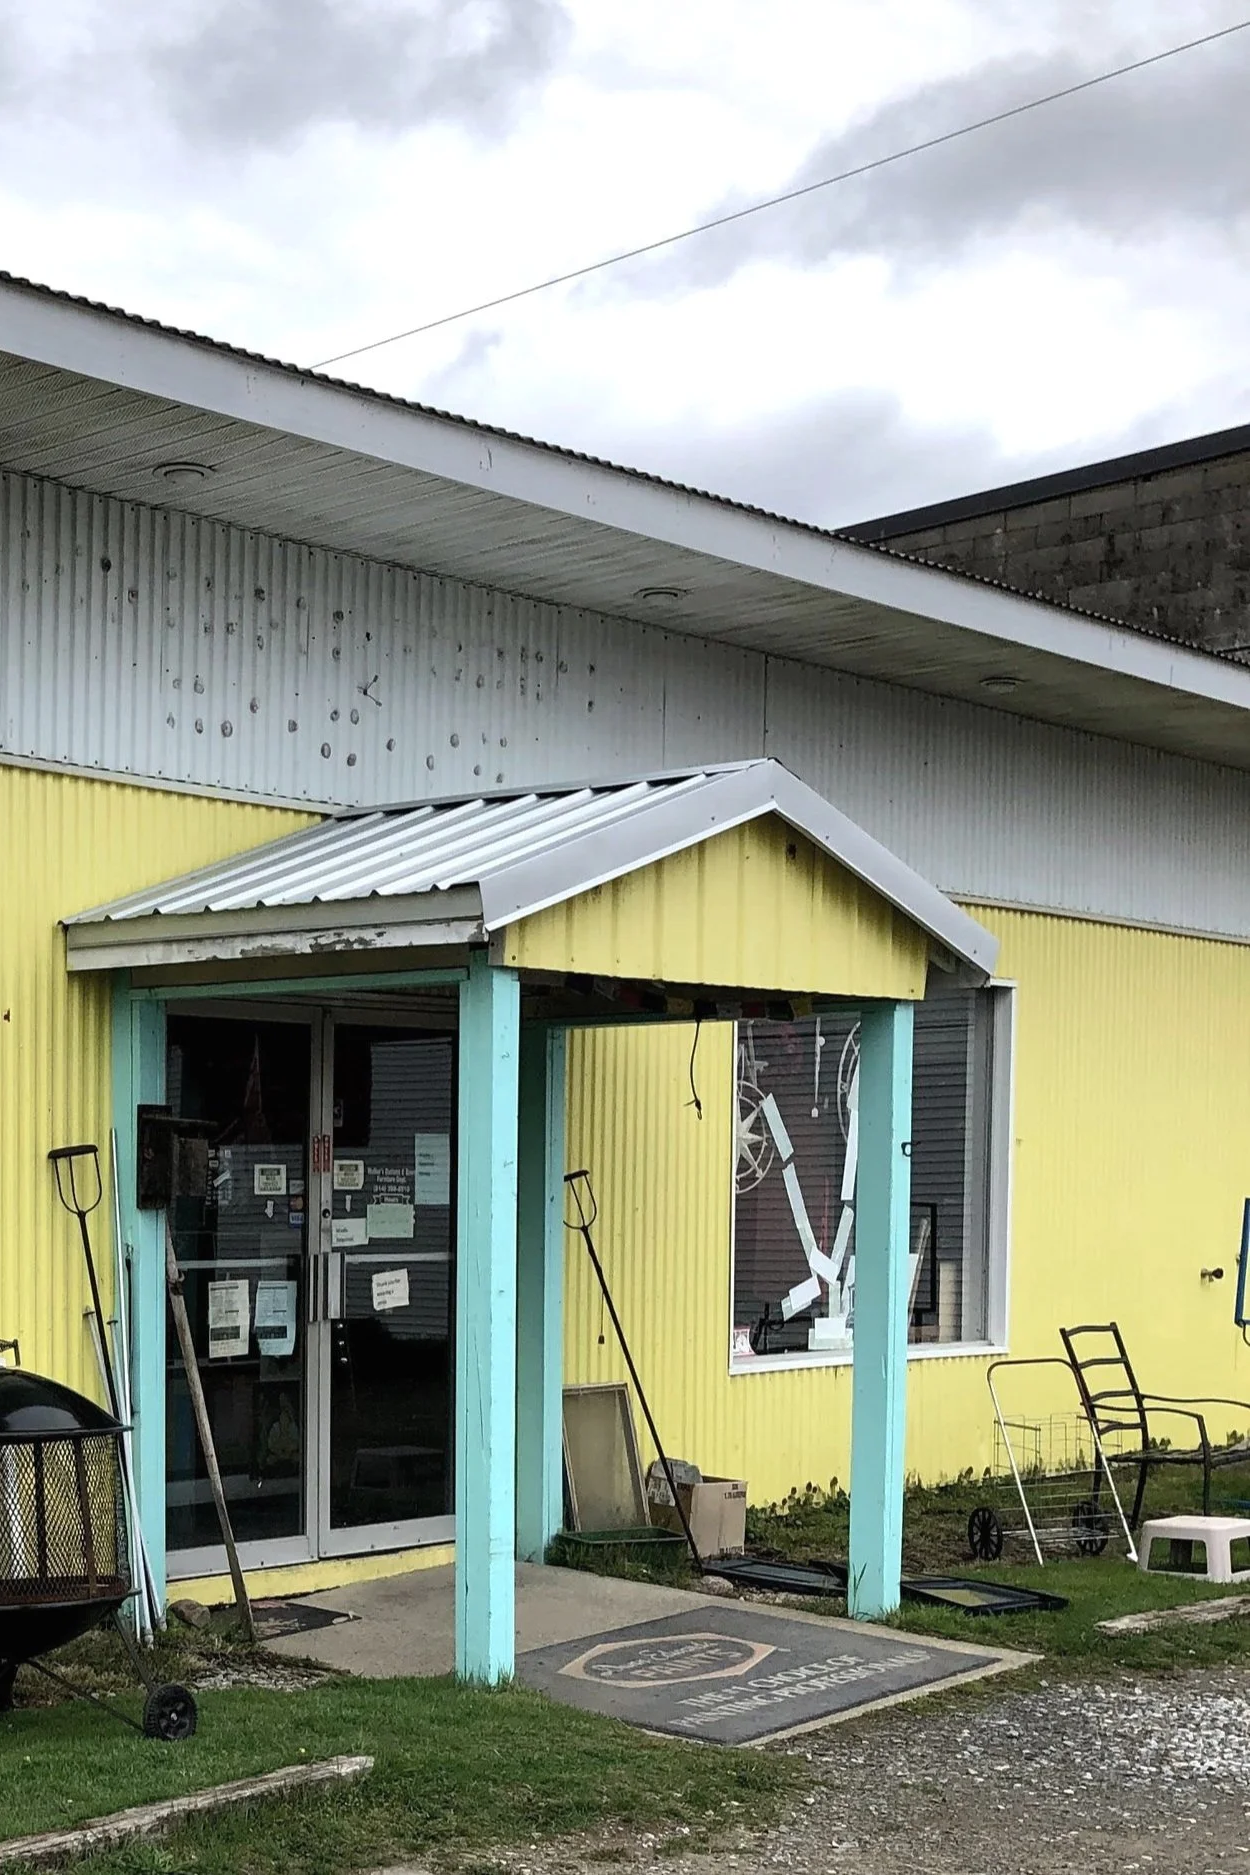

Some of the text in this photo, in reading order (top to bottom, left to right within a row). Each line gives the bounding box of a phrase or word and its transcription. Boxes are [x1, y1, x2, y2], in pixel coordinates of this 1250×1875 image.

[629, 1648, 743, 1678] PAINTS
[676, 1691, 734, 1707] THE
[746, 1662, 837, 1688] CHOICE
[825, 1654, 866, 1667] OF
[669, 1694, 783, 1728] PAINTING
